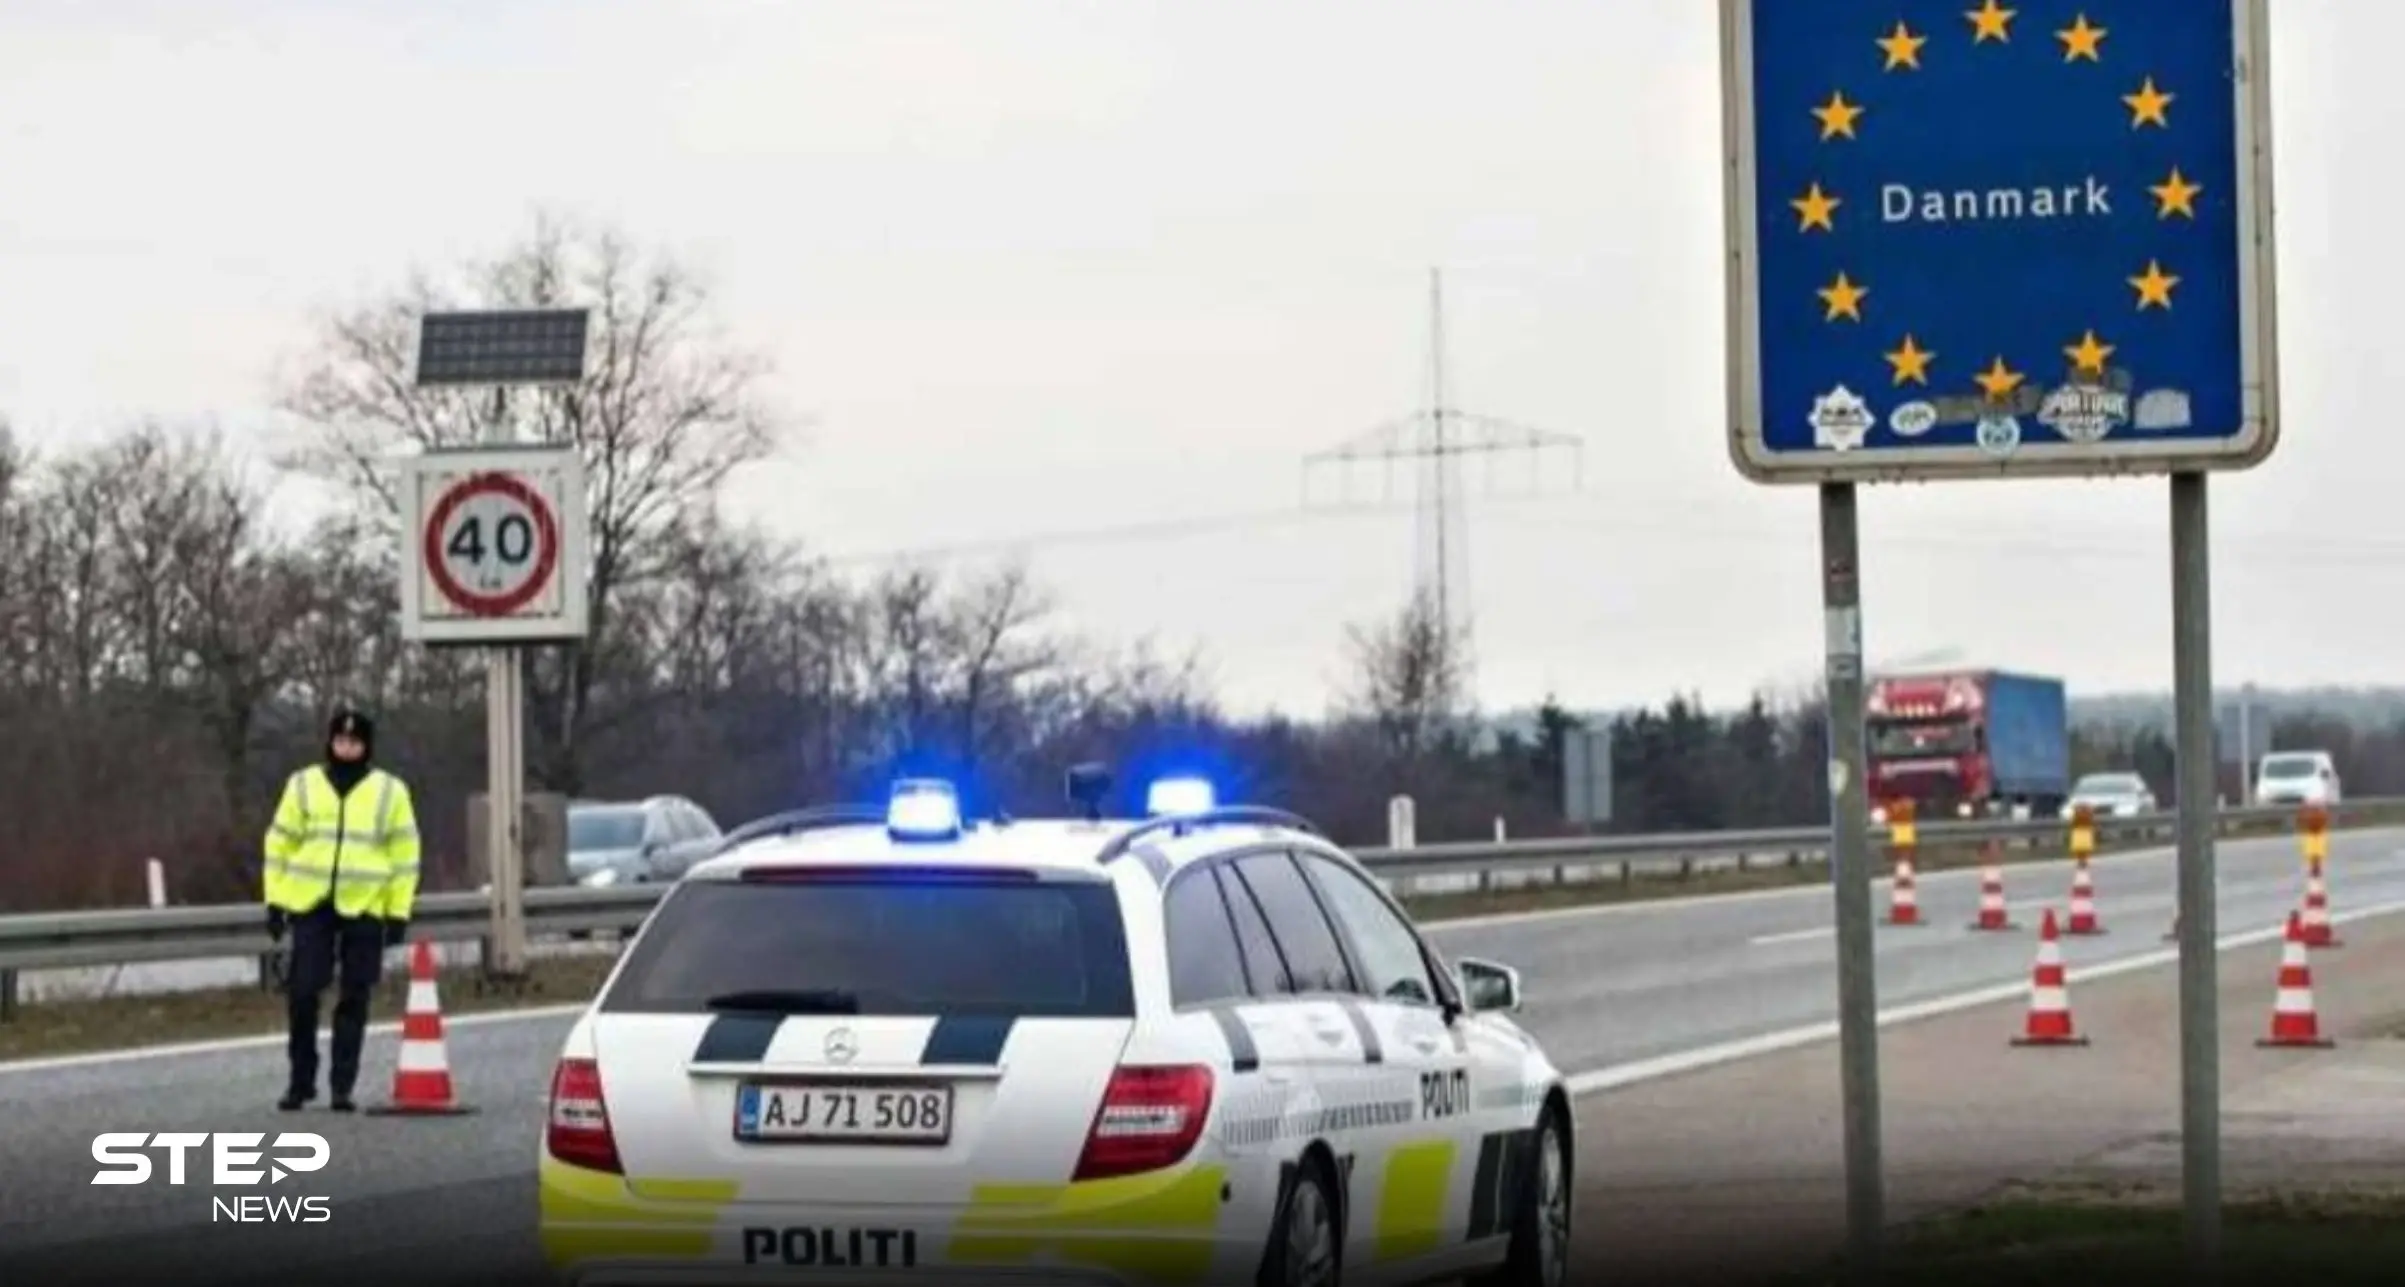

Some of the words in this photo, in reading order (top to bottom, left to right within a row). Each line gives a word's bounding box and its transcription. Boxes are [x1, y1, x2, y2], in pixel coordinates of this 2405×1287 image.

[1881, 174, 2112, 222] Danmark
[447, 514, 532, 566] 40
[765, 1093, 811, 1128] AJ
[822, 1094, 860, 1128] 71
[874, 1094, 941, 1129] 508
[743, 1226, 917, 1268] POLITI
